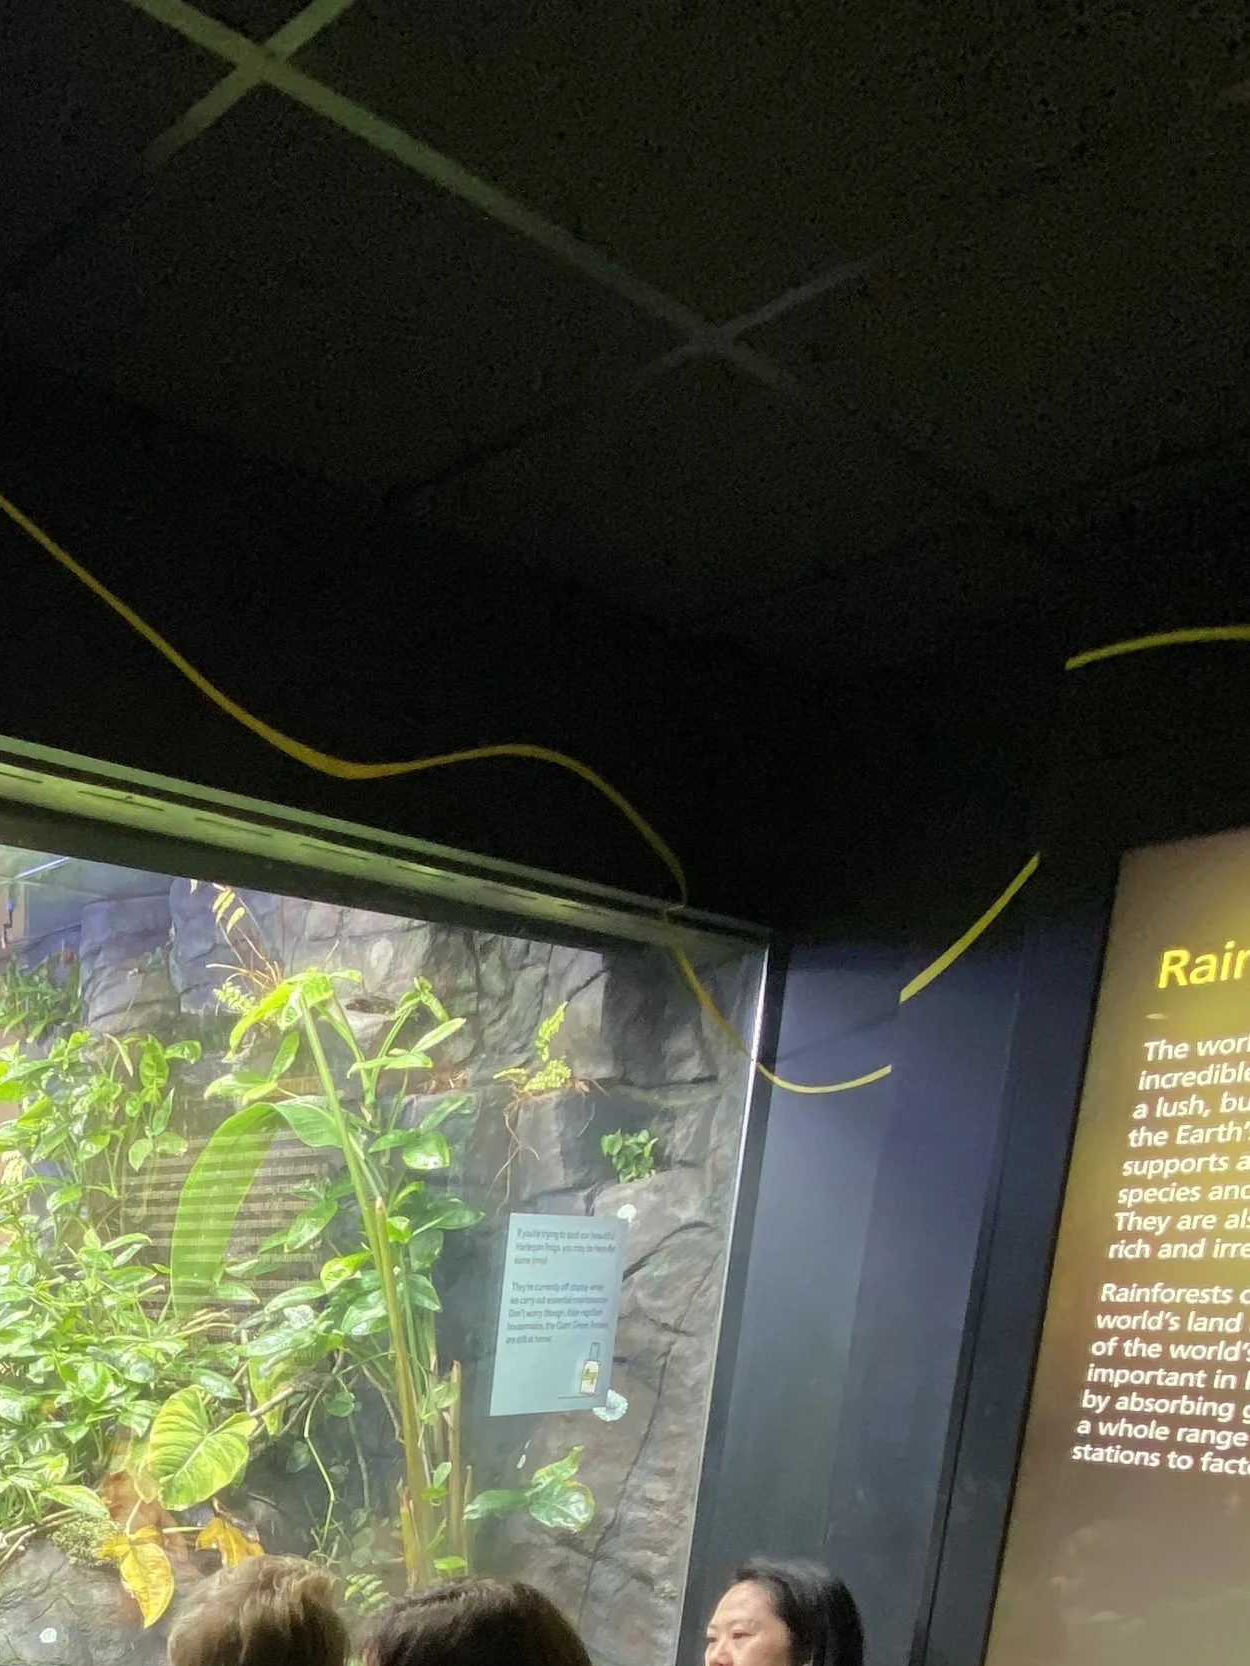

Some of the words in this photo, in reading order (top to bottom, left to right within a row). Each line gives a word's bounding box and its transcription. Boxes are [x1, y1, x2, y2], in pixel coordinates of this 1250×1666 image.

[1144, 1039, 1190, 1061] The
[1132, 1103, 1149, 1120] a
[1156, 1094, 1210, 1118] lush,
[1128, 1126, 1169, 1148] the
[1176, 1121, 1250, 1145] Earth'
[1122, 1153, 1230, 1180] supports
[1117, 1182, 1202, 1209] species
[1114, 1210, 1171, 1236] They
[1177, 1213, 1217, 1231] are
[1224, 1207, 1250, 1230] al
[1109, 1238, 1151, 1259] rich
[1157, 1237, 1206, 1259] and
[1101, 1282, 1233, 1304] Rainforests
[1096, 1309, 1181, 1332] world's
[1187, 1311, 1244, 1333] land
[1091, 1336, 1120, 1356] of
[1123, 1337, 1162, 1358] the
[1087, 1363, 1207, 1388] important
[1213, 1369, 1237, 1389] in
[1082, 1389, 1111, 1413] by
[1115, 1391, 1235, 1423] absorbing
[1076, 1419, 1091, 1435] a
[1099, 1418, 1170, 1441] whole
[1176, 1427, 1249, 1450] range
[1072, 1444, 1161, 1467] stations
[1167, 1451, 1194, 1470] to
[1200, 1451, 1250, 1475] fact
